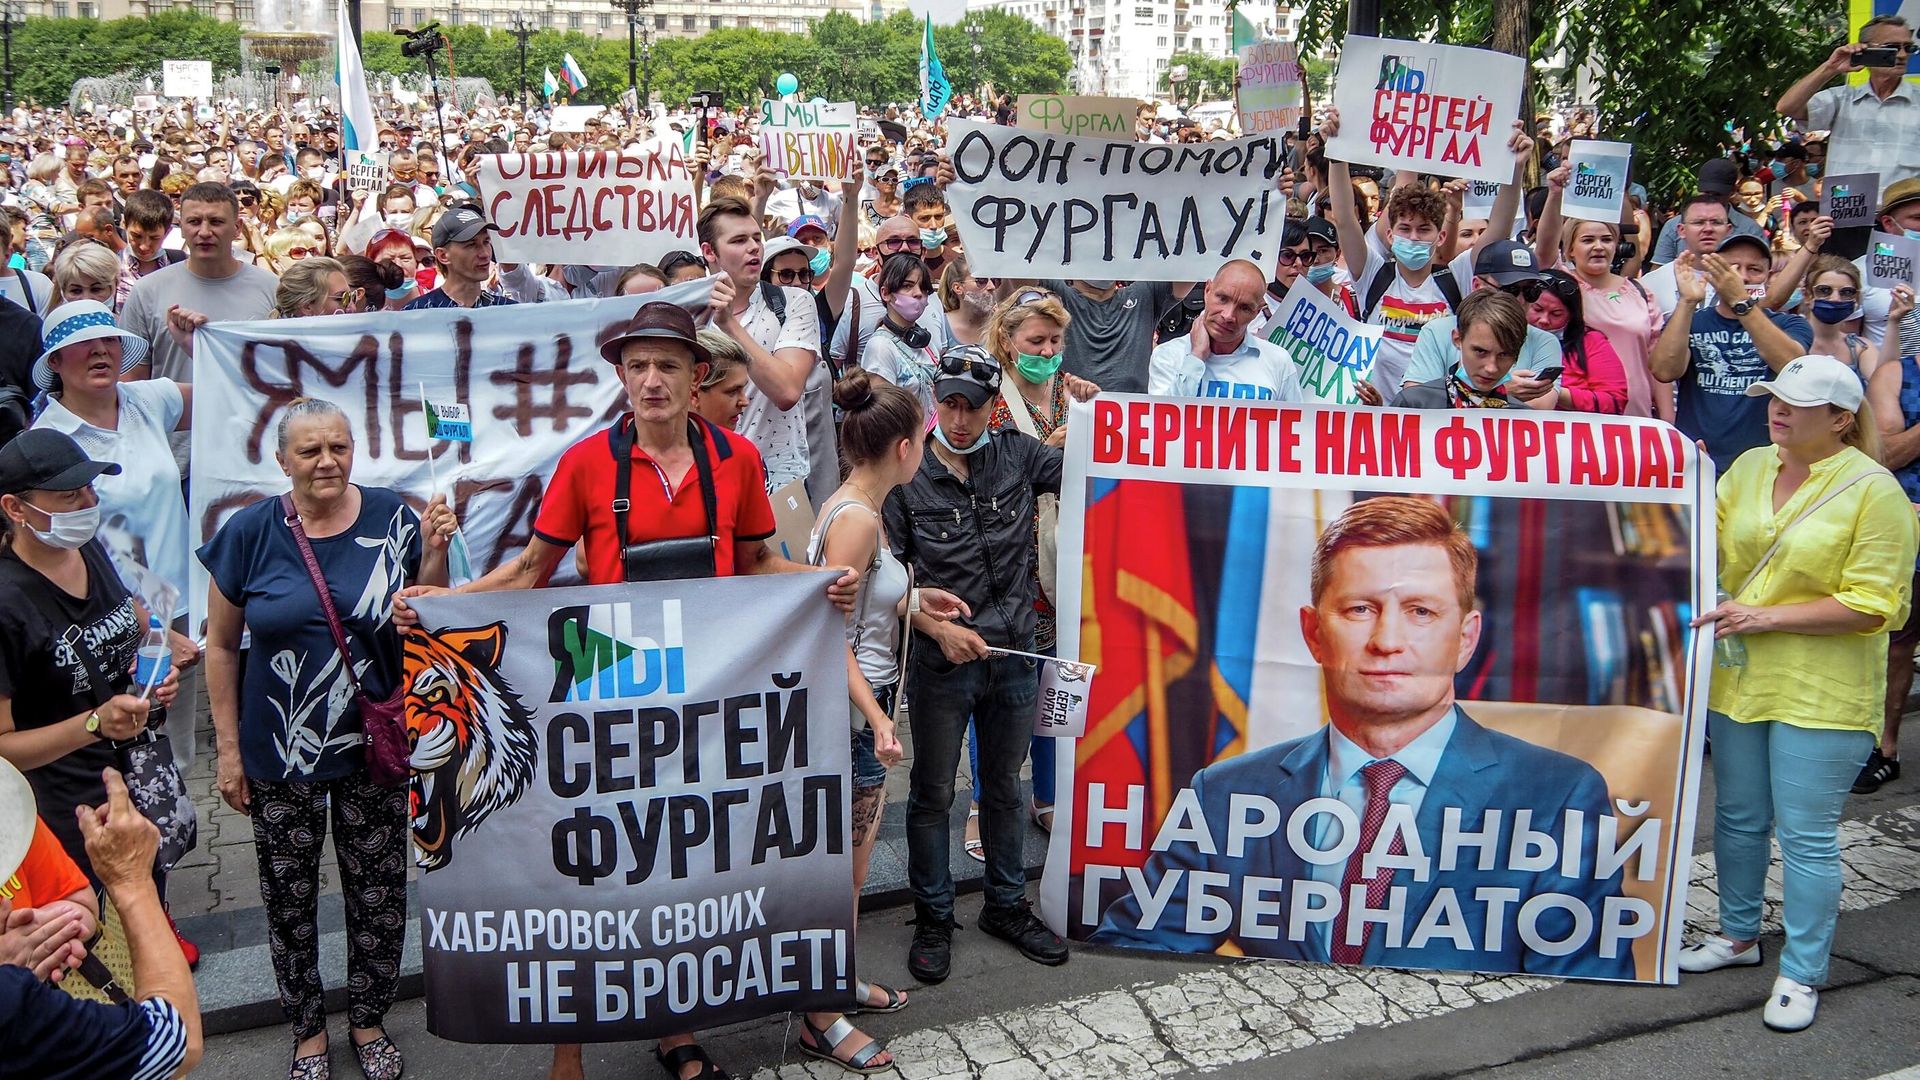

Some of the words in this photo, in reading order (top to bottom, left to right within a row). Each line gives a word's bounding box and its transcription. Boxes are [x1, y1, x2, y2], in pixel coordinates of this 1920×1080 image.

[1372, 89, 1493, 135] СЕРГЕЙ
[764, 132, 855, 179] ЦВЕТКОВА
[1370, 120, 1481, 167] ФУРГАЛ
[350, 177, 382, 191] ФУРГАЛ
[351, 164, 384, 179] СЕРГЕЙ
[1474, 184, 1500, 196] ФУРГ
[1574, 185, 1613, 199] ФУРГАЛ
[1576, 173, 1612, 188] СЕРГЕЙ
[490, 184, 693, 241] СЛЕДСТВИЯ
[1830, 206, 1867, 219] ФУРГАЛ
[1831, 194, 1866, 208] СЕРГЕЙ
[972, 190, 1269, 264] ФУРГАЛУ!
[1873, 253, 1912, 271] СЕРГЕЙ
[1873, 266, 1914, 283] ФУРГАЛ
[1286, 297, 1382, 371] СВОБОДУ
[1094, 401, 1302, 473] ВЕРНИТЕ
[1315, 411, 1421, 480] НАМ
[1435, 416, 1685, 489] ФУРГАЛА!
[1041, 687, 1056, 728] ФУРГАЛ
[1054, 690, 1069, 726] СЕРГЕЙ
[546, 671, 809, 798] СЕРГЕЙ
[552, 775, 844, 886] ФУРГАЛ
[1086, 782, 1662, 882] НАРОДНЫЙ
[427, 907, 642, 953] ХАБАРОВСК
[652, 886, 767, 946] СВОИХ
[1082, 863, 1656, 960] ГУБЕРНАТОР
[507, 960, 578, 1023] НЕ
[596, 929, 848, 1020] БРОСАЕТ!
